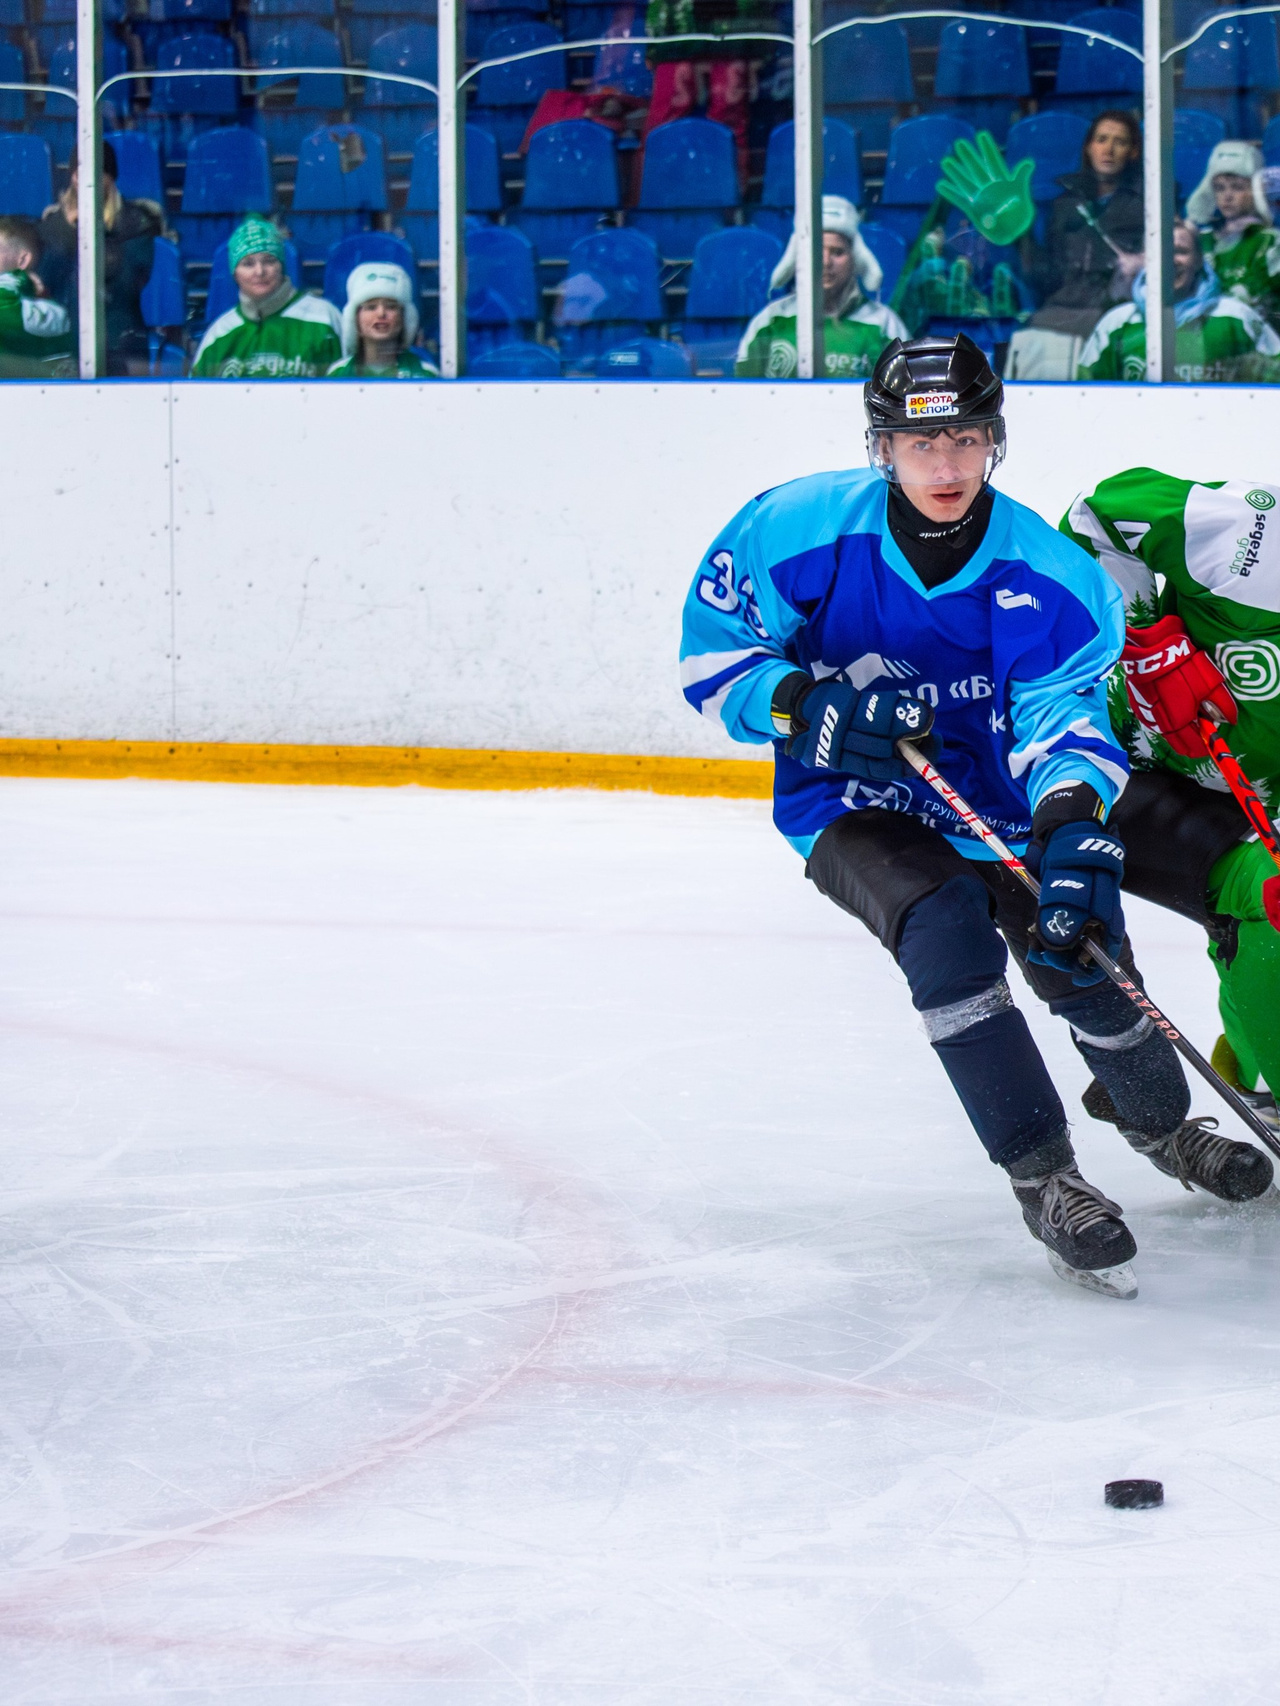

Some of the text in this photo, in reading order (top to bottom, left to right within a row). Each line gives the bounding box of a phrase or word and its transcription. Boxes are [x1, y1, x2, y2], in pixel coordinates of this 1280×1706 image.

[910, 395, 953, 406] ВОРОТА
[911, 405, 955, 415] В СПОРТ
[1229, 537, 1250, 575] group
[1239, 513, 1266, 577] segezha
[1120, 639, 1191, 676] CCM
[1117, 981, 1180, 1040] FLYPRO
